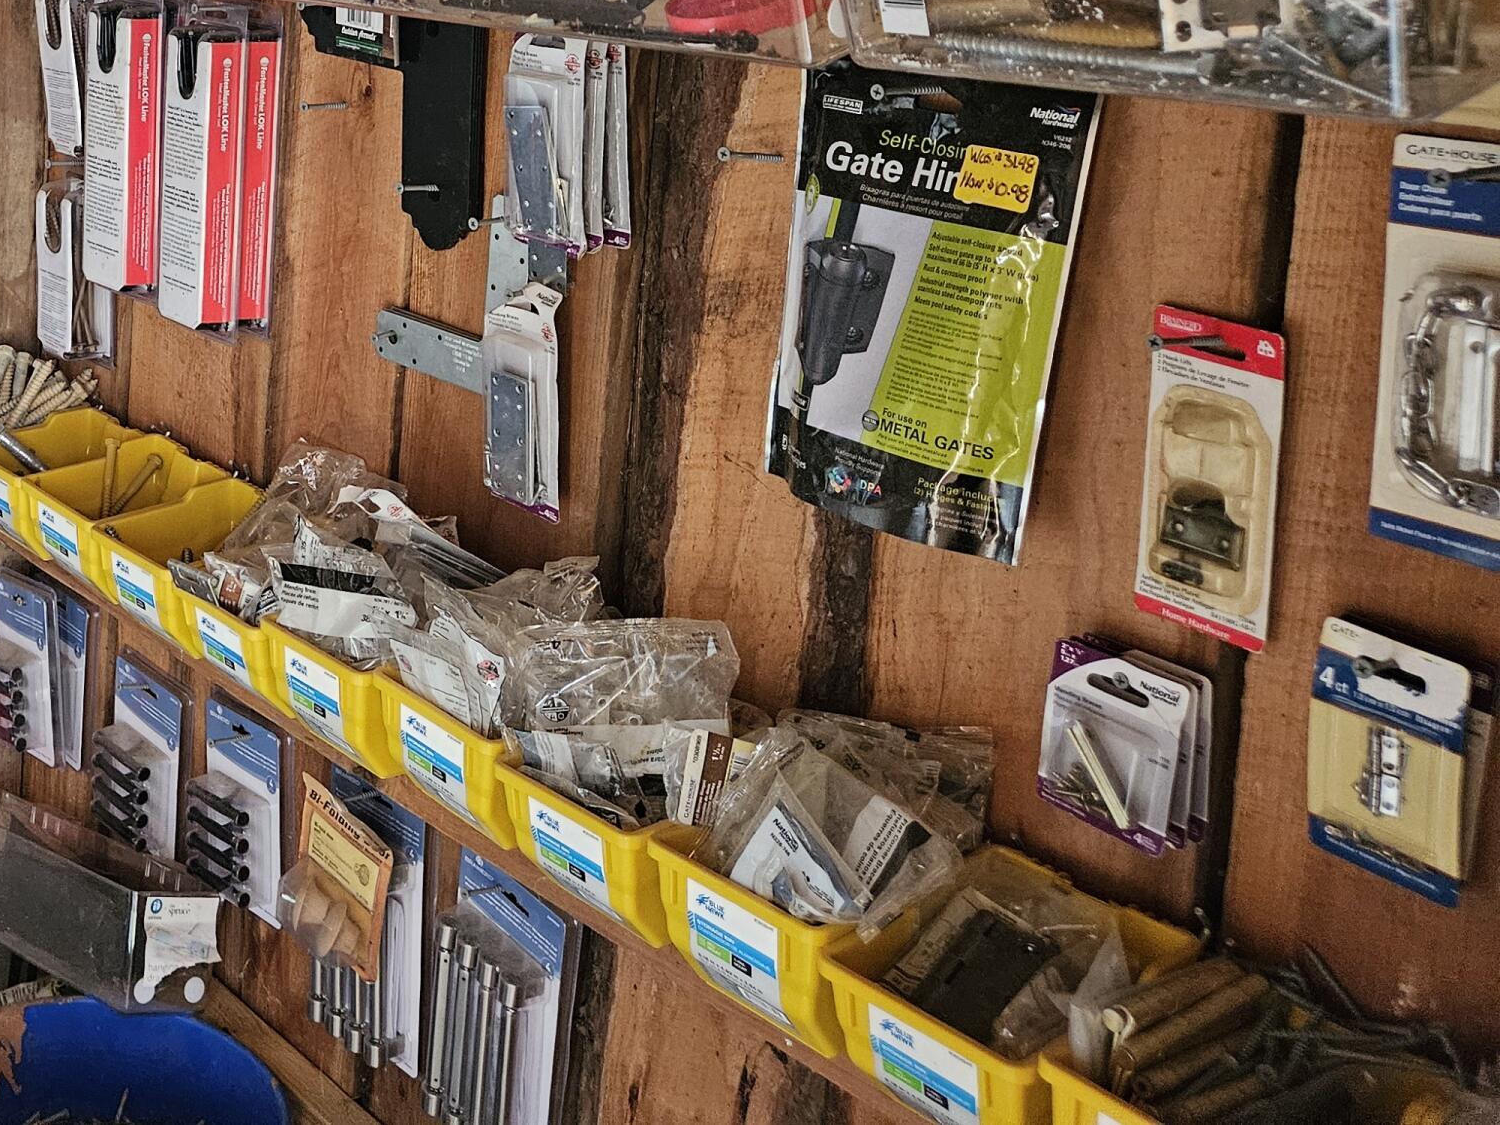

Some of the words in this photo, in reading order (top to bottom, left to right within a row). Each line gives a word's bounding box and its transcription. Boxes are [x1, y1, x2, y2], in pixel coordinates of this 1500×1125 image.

[141, 86, 150, 105] LOK
[823, 94, 862, 109] LIFESPAN
[221, 111, 230, 131] LOK
[257, 110, 267, 130] LOK
[1029, 106, 1081, 125] National
[826, 139, 904, 184] Gate
[931, 231, 961, 246] Adjustable
[960, 237, 996, 253] self-closing
[958, 249, 974, 261] gates
[973, 253, 983, 263] up
[922, 263, 934, 274] Rust
[967, 274, 987, 285] proof
[919, 275, 946, 290] Industrial
[945, 282, 970, 296] strength
[1004, 293, 1024, 305] with
[913, 295, 930, 306] Meets
[930, 300, 944, 311] pool
[943, 301, 964, 316] safety
[955, 295, 1003, 311] componnts
[881, 407, 896, 418] For
[896, 412, 913, 425] use
[913, 418, 927, 429] on
[879, 418, 929, 446] METAL
[934, 435, 995, 461] GATES
[859, 478, 882, 497] DPA
[1161, 607, 1187, 624] Home
[1188, 614, 1231, 641] Hardware
[1318, 665, 1336, 690] 4
[1335, 681, 1350, 694] ct
[1139, 679, 1181, 704] National
[772, 818, 800, 853] National
